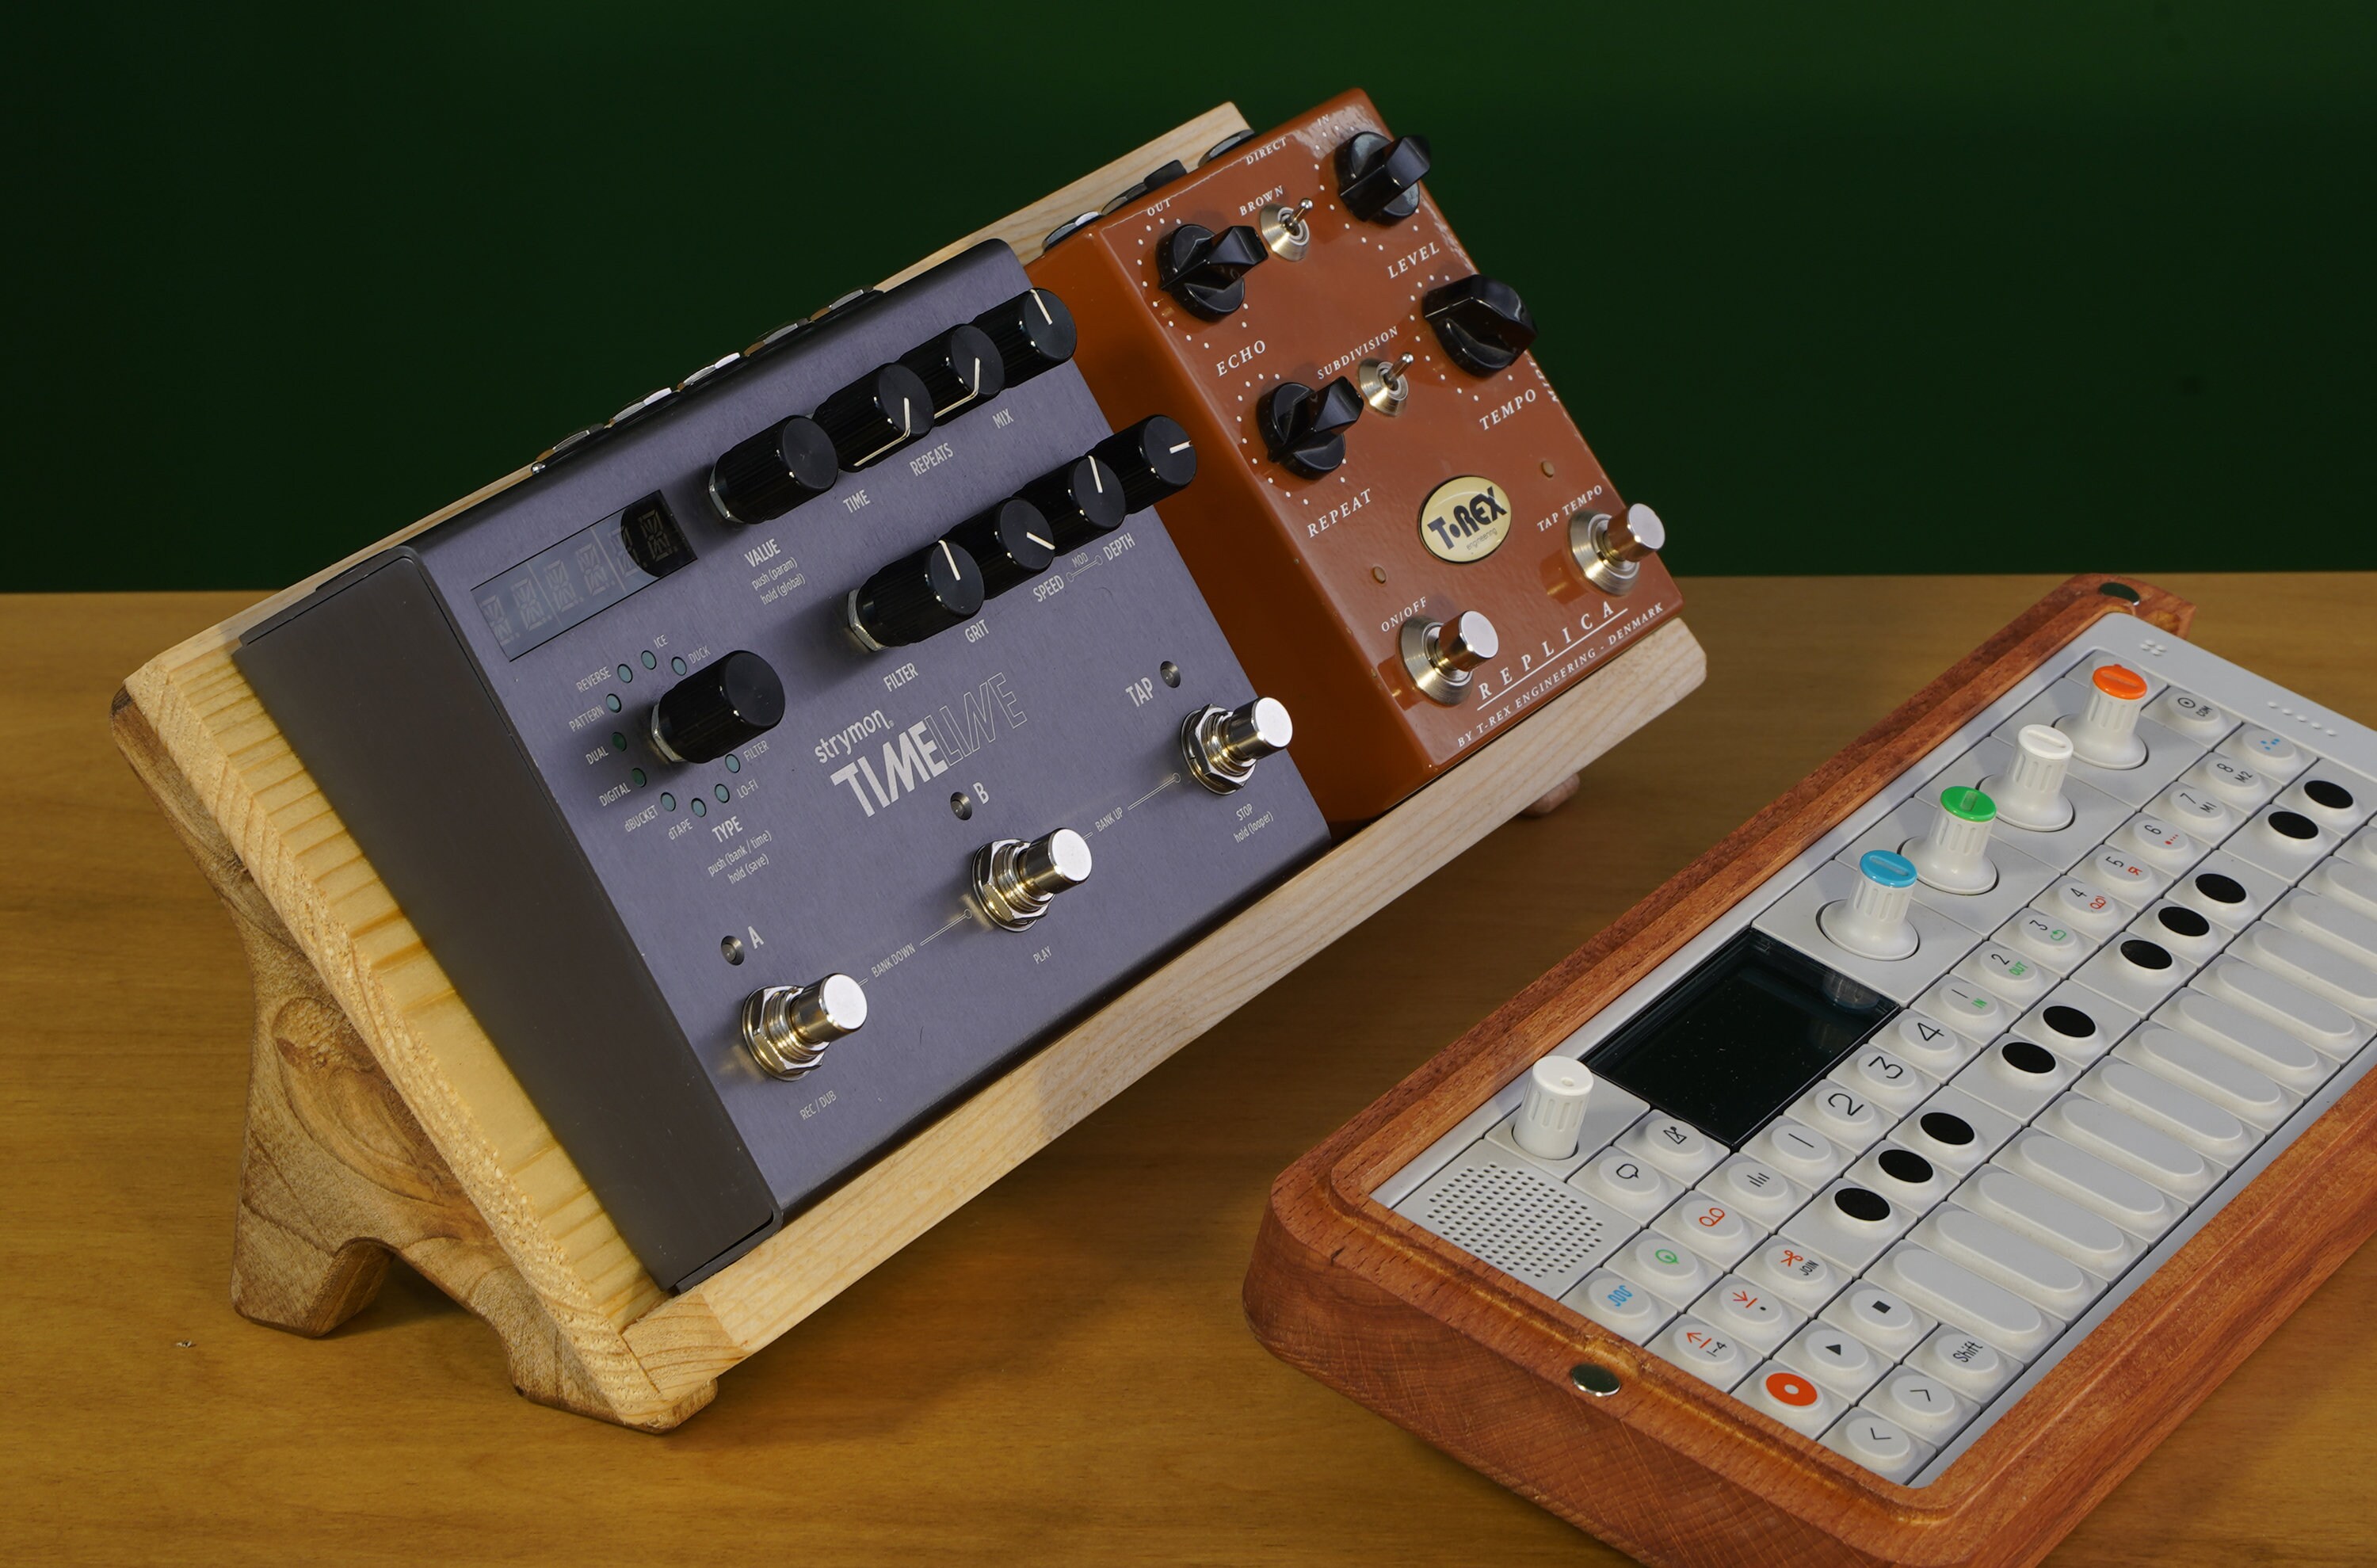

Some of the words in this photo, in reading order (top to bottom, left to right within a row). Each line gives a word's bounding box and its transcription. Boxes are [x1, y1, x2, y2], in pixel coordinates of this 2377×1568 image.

[1317, 114, 1330, 126] IN
[1246, 136, 1288, 166] DIRECT
[1147, 198, 1171, 216] OUT
[1239, 185, 1284, 216] BROWN
[1387, 242, 1440, 278] LEVEL
[1215, 340, 1266, 376] ECHO
[1317, 326, 1398, 380] SUBDIVISION
[992, 408, 1014, 429] MIX
[1479, 389, 1536, 430] TEMPO
[910, 443, 954, 476] REPEATS
[843, 489, 870, 513] TIME
[1307, 488, 1372, 538] REPEAT
[1536, 512, 1559, 532] TAP
[1562, 485, 1603, 516] TEMPO
[744, 538, 781, 568] VALUE
[1103, 532, 1135, 562] DEPTH
[1072, 551, 1089, 568] MOD
[752, 571, 771, 591] push
[769, 557, 798, 582] (param)
[760, 587, 777, 605] hold
[776, 573, 807, 598] (global)
[1032, 574, 1065, 602] SPEED
[1381, 596, 1427, 632] ON/OFF
[654, 634, 669, 650] ICE
[964, 619, 989, 643] GRIT
[688, 645, 711, 665] DUCK
[576, 666, 612, 692] REVERSE
[883, 662, 919, 692] FILTER
[1457, 731, 1472, 748] BY
[1476, 705, 1511, 734] T-REX
[1515, 648, 1597, 708] ENGINEERING
[1608, 602, 1664, 646] DENMARK
[1125, 677, 1154, 708] TAP
[569, 706, 605, 732] PATTERN
[2196, 705, 2213, 718] COM
[585, 746, 609, 765] DUAL
[742, 740, 769, 762] FILTER
[830, 672, 1028, 818] TIMELINE
[736, 779, 759, 799] LO-FI
[2234, 771, 2253, 783] M2
[598, 782, 631, 807] DIGITAL
[973, 781, 990, 805] B
[2180, 792, 2196, 805] 7
[624, 804, 658, 832] dBUCKET
[1236, 803, 1253, 821] STOP
[2200, 801, 2218, 813] M1
[668, 818, 693, 841] dTAPE
[712, 815, 743, 843] TYPE
[1095, 815, 1116, 833] BANK
[1113, 807, 1124, 820] UP
[1233, 829, 1250, 843] hold
[1248, 811, 1274, 835] (looper)
[2144, 824, 2161, 835] 6
[708, 856, 727, 877] push
[725, 845, 747, 866] (bank
[751, 830, 773, 849] time)
[2105, 856, 2124, 868] 5
[727, 866, 746, 884] hold
[744, 853, 770, 876] (save)
[2070, 887, 2088, 898] 4
[747, 925, 765, 949] A
[2029, 919, 2048, 931] 3
[871, 958, 895, 979] BANK
[891, 943, 917, 966] DOWN
[1032, 945, 1053, 964] PLAY
[1990, 953, 2010, 965] 2
[2009, 961, 2028, 976] OUT
[1971, 998, 1987, 1009] IN
[1917, 1022, 1944, 1041] 4
[1868, 1055, 1903, 1079] 3
[799, 1104, 817, 1120] REC
[818, 1090, 837, 1109] DUB
[1827, 1093, 1864, 1116] 2
[1799, 1260, 1819, 1276] JOIN
[1952, 1341, 1984, 1363] Shift
